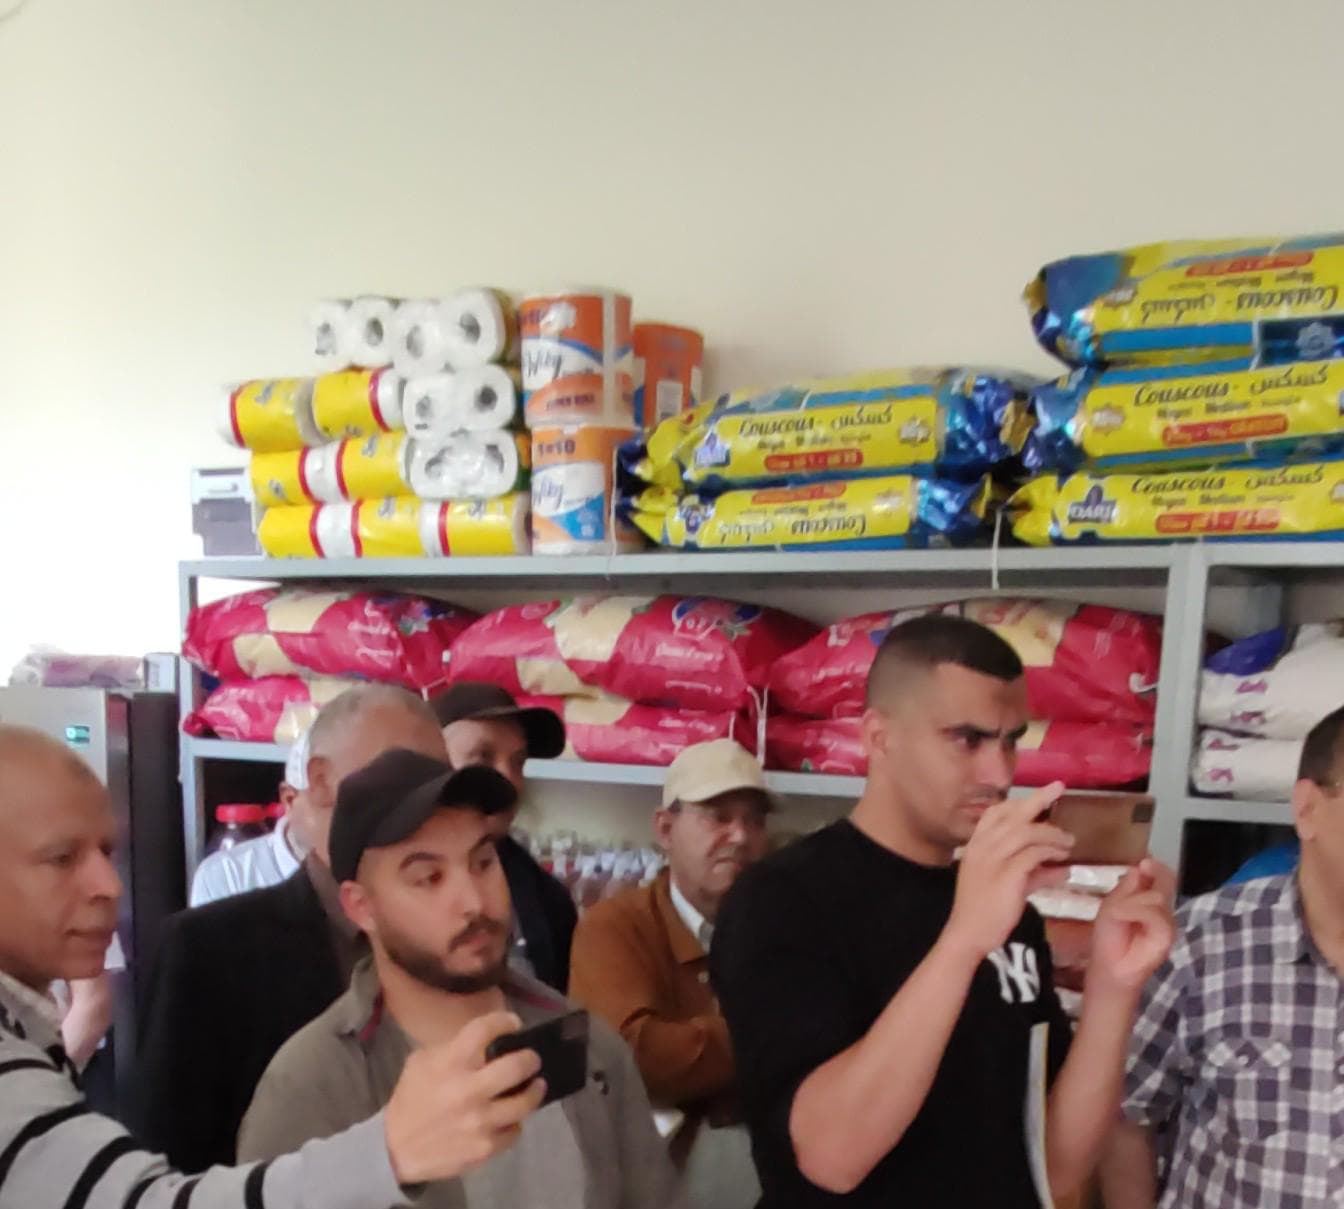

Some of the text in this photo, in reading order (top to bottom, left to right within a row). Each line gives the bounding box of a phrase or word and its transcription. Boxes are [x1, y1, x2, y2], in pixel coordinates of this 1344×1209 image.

[1141, 284, 1339, 324] Couscous كسكس
[1133, 365, 1329, 407] Couscous كسكس
[738, 404, 894, 437] Couscous كسكس
[1131, 464, 1325, 495] Couscous كسكس
[791, 514, 868, 537] Couscous
[1069, 501, 1117, 522] DARI
[986, 942, 1041, 1004] NY
